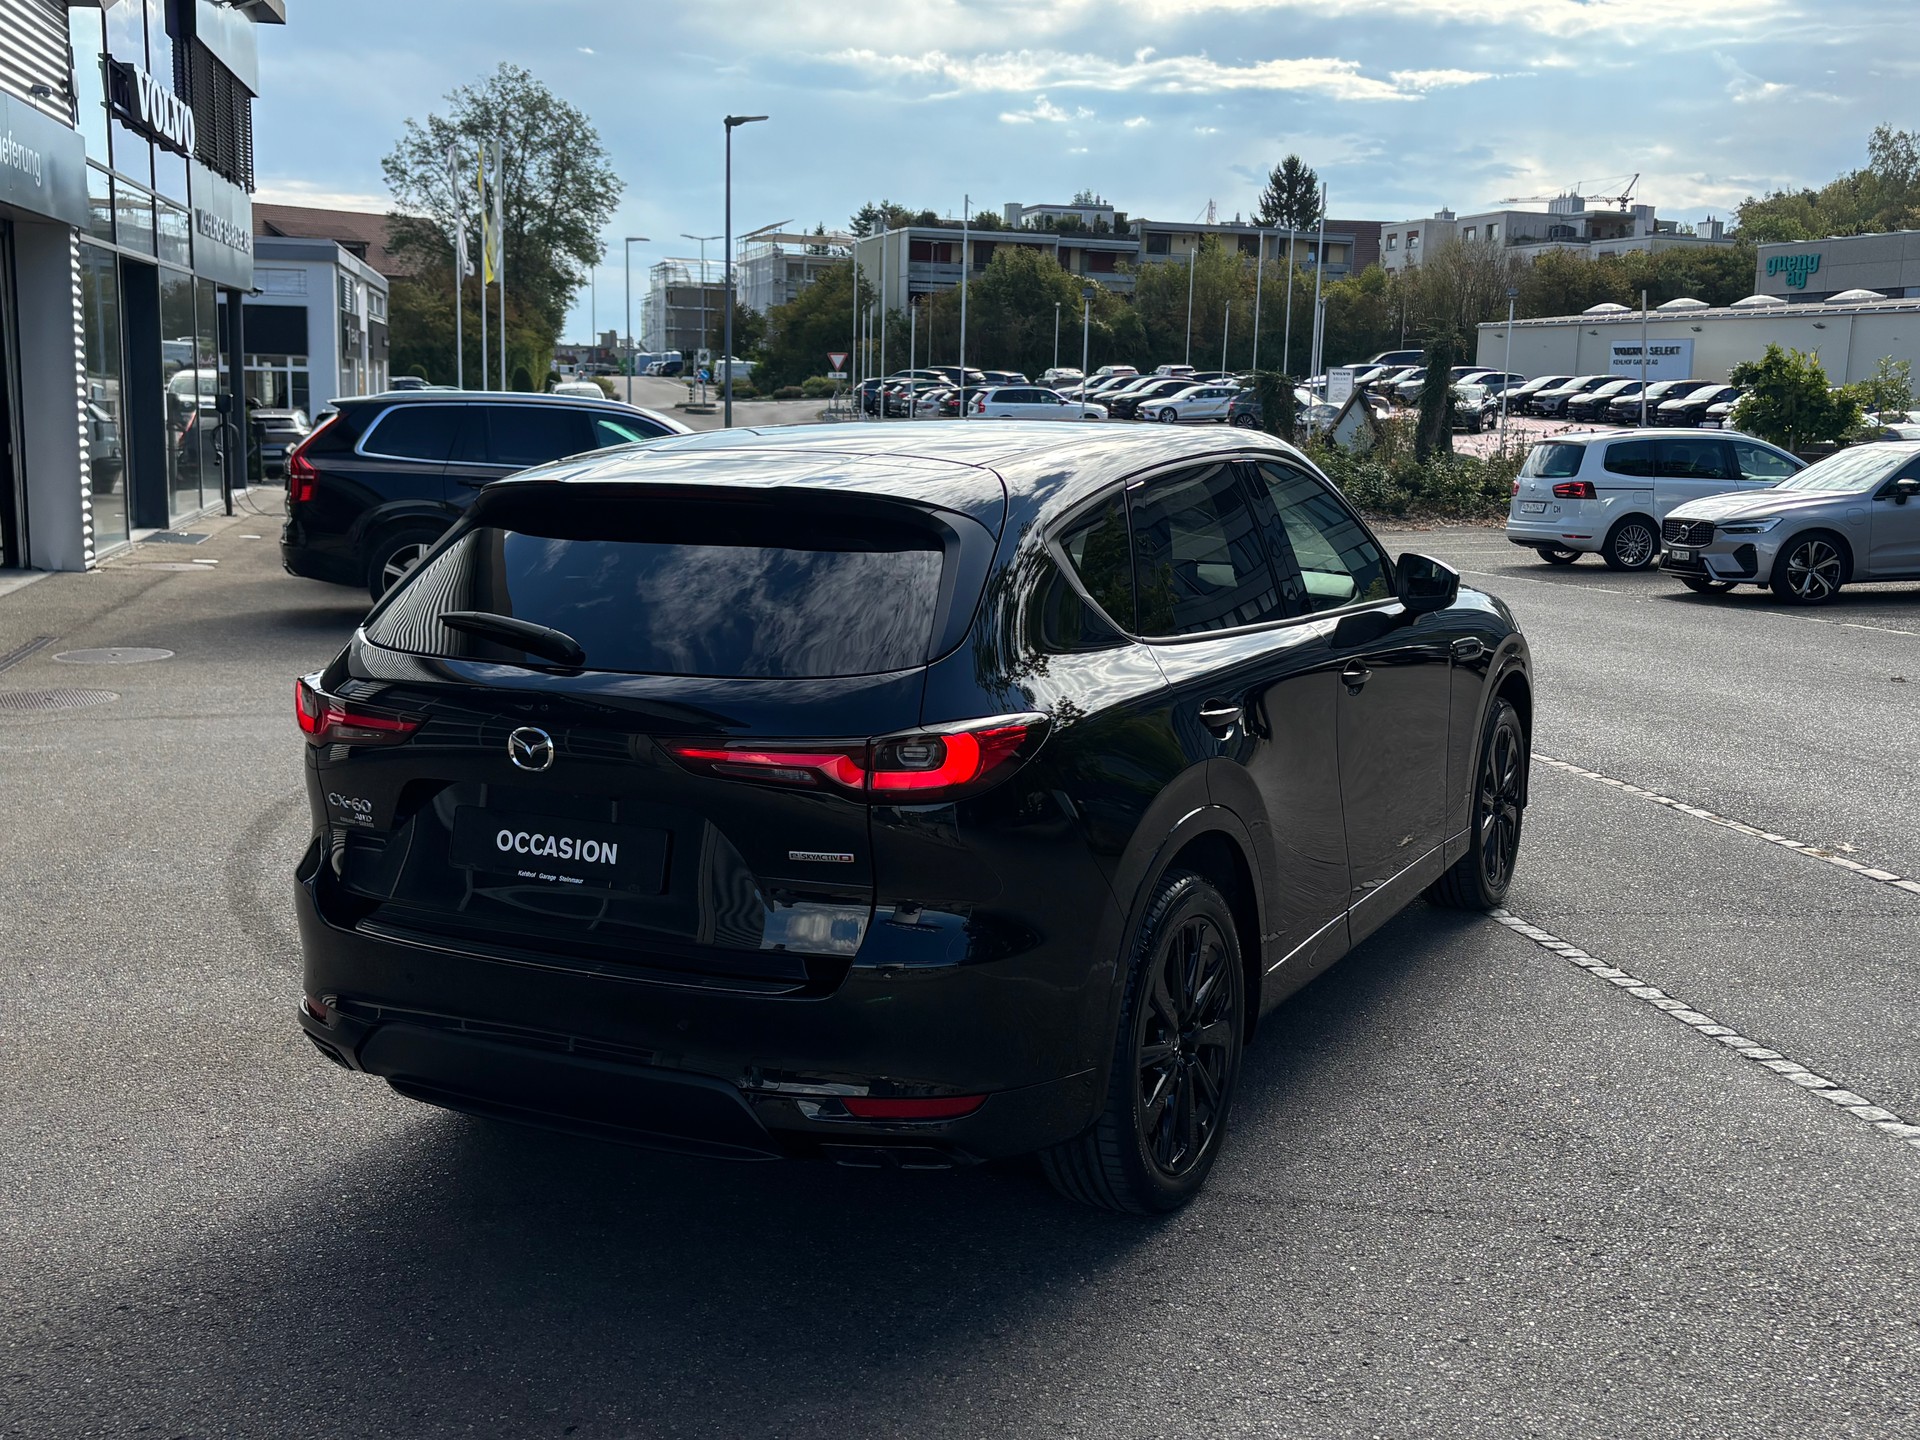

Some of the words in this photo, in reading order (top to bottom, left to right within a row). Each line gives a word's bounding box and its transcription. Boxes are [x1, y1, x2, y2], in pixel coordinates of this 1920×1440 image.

[134, 63, 195, 154] VOLVO
[1766, 253, 1821, 277] gueng
[1786, 270, 1807, 289] ag
[1649, 346, 1681, 355] SELEKT
[328, 792, 372, 813] CX-60
[496, 829, 618, 865] OCCASION
[802, 853, 839, 861] SKYACTIV
[539, 872, 557, 881] Garage
